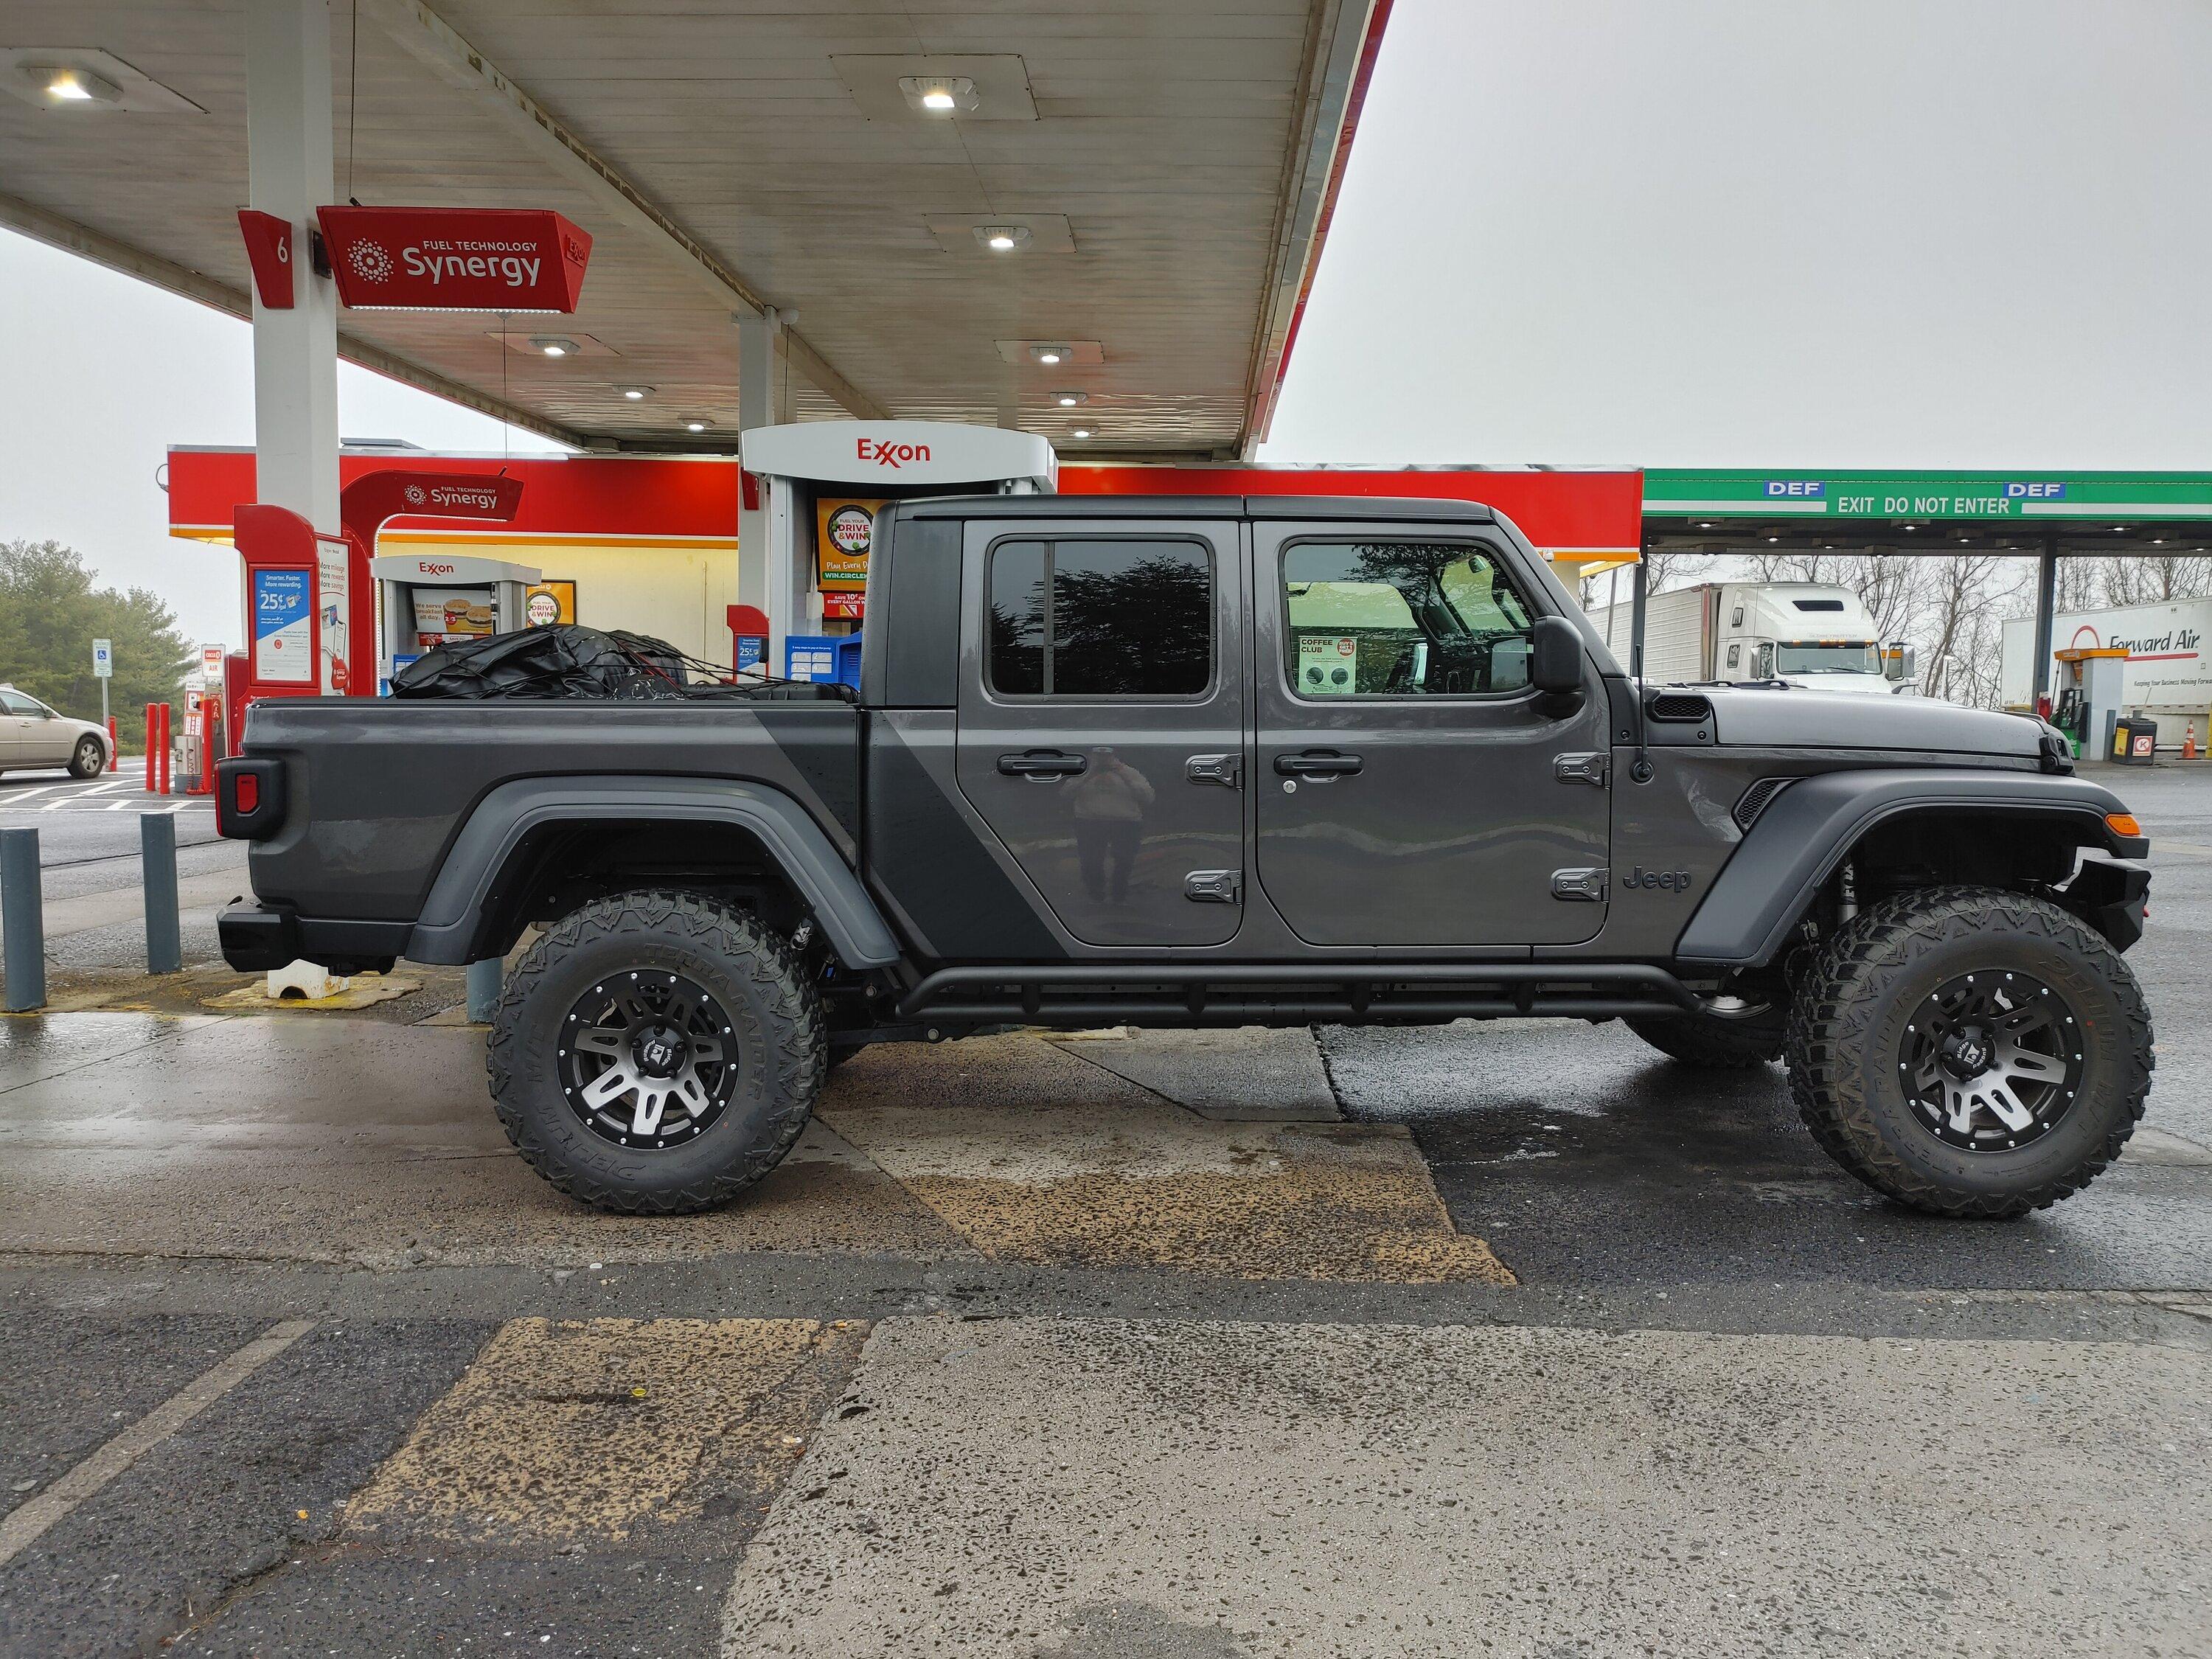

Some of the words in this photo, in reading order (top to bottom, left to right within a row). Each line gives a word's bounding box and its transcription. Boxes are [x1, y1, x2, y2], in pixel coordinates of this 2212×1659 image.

[278, 236, 288, 263] 6
[423, 240, 453, 251] FUEL
[456, 241, 538, 252] TECHNOLOGY
[403, 247, 541, 287] Synergy
[858, 438, 931, 468] Exxon
[431, 489, 497, 509] Synergy
[1769, 482, 1820, 495] DEF
[2008, 484, 2061, 497] DEF
[1838, 497, 1874, 513] EXIT
[1885, 497, 1908, 513] DO
[1914, 497, 1949, 513] NOT
[1954, 498, 2010, 514] ENTER
[419, 562, 454, 576] Exxon
[827, 561, 841, 570] Play
[843, 561, 861, 569] Every
[2110, 631, 2172, 653] Forward
[2174, 629, 2200, 650] Air
[1623, 866, 1692, 893] Jeep
[644, 943, 731, 992] TERRA
[644, 1039, 655, 1062] Rugged
[661, 1048, 672, 1066] Ridge
[728, 992, 767, 1101] RAIDER
[1957, 1041, 1969, 1059] Ridge
[1972, 1047, 1987, 1069] Rugged
